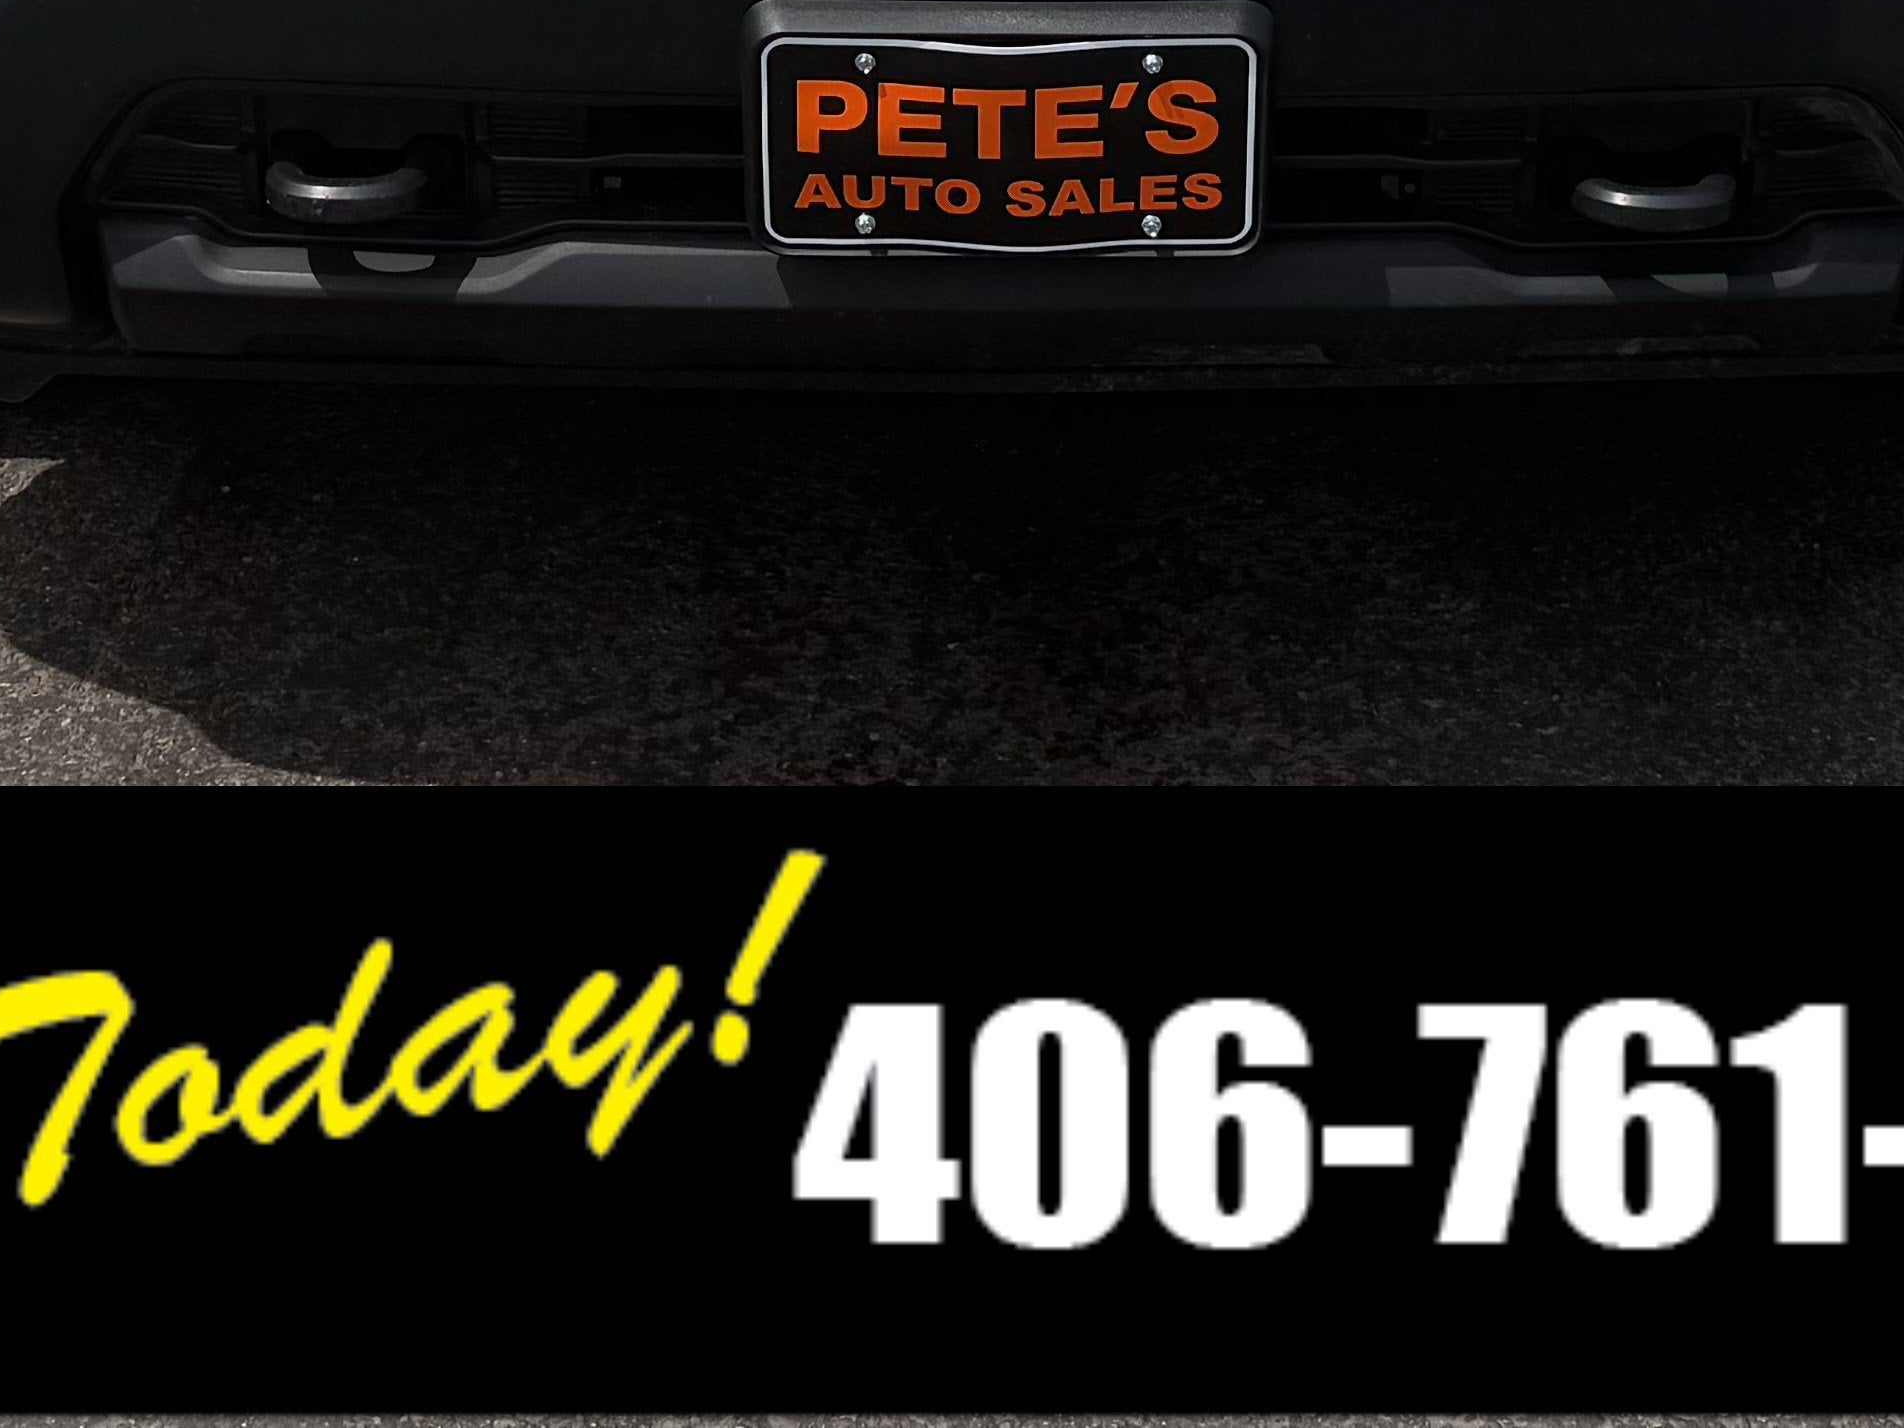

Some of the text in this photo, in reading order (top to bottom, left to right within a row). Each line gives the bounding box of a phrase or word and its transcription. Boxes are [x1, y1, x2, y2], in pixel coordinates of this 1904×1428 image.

[796, 79, 1221, 160] PETE'S
[794, 171, 1224, 218] AUTO SALES
